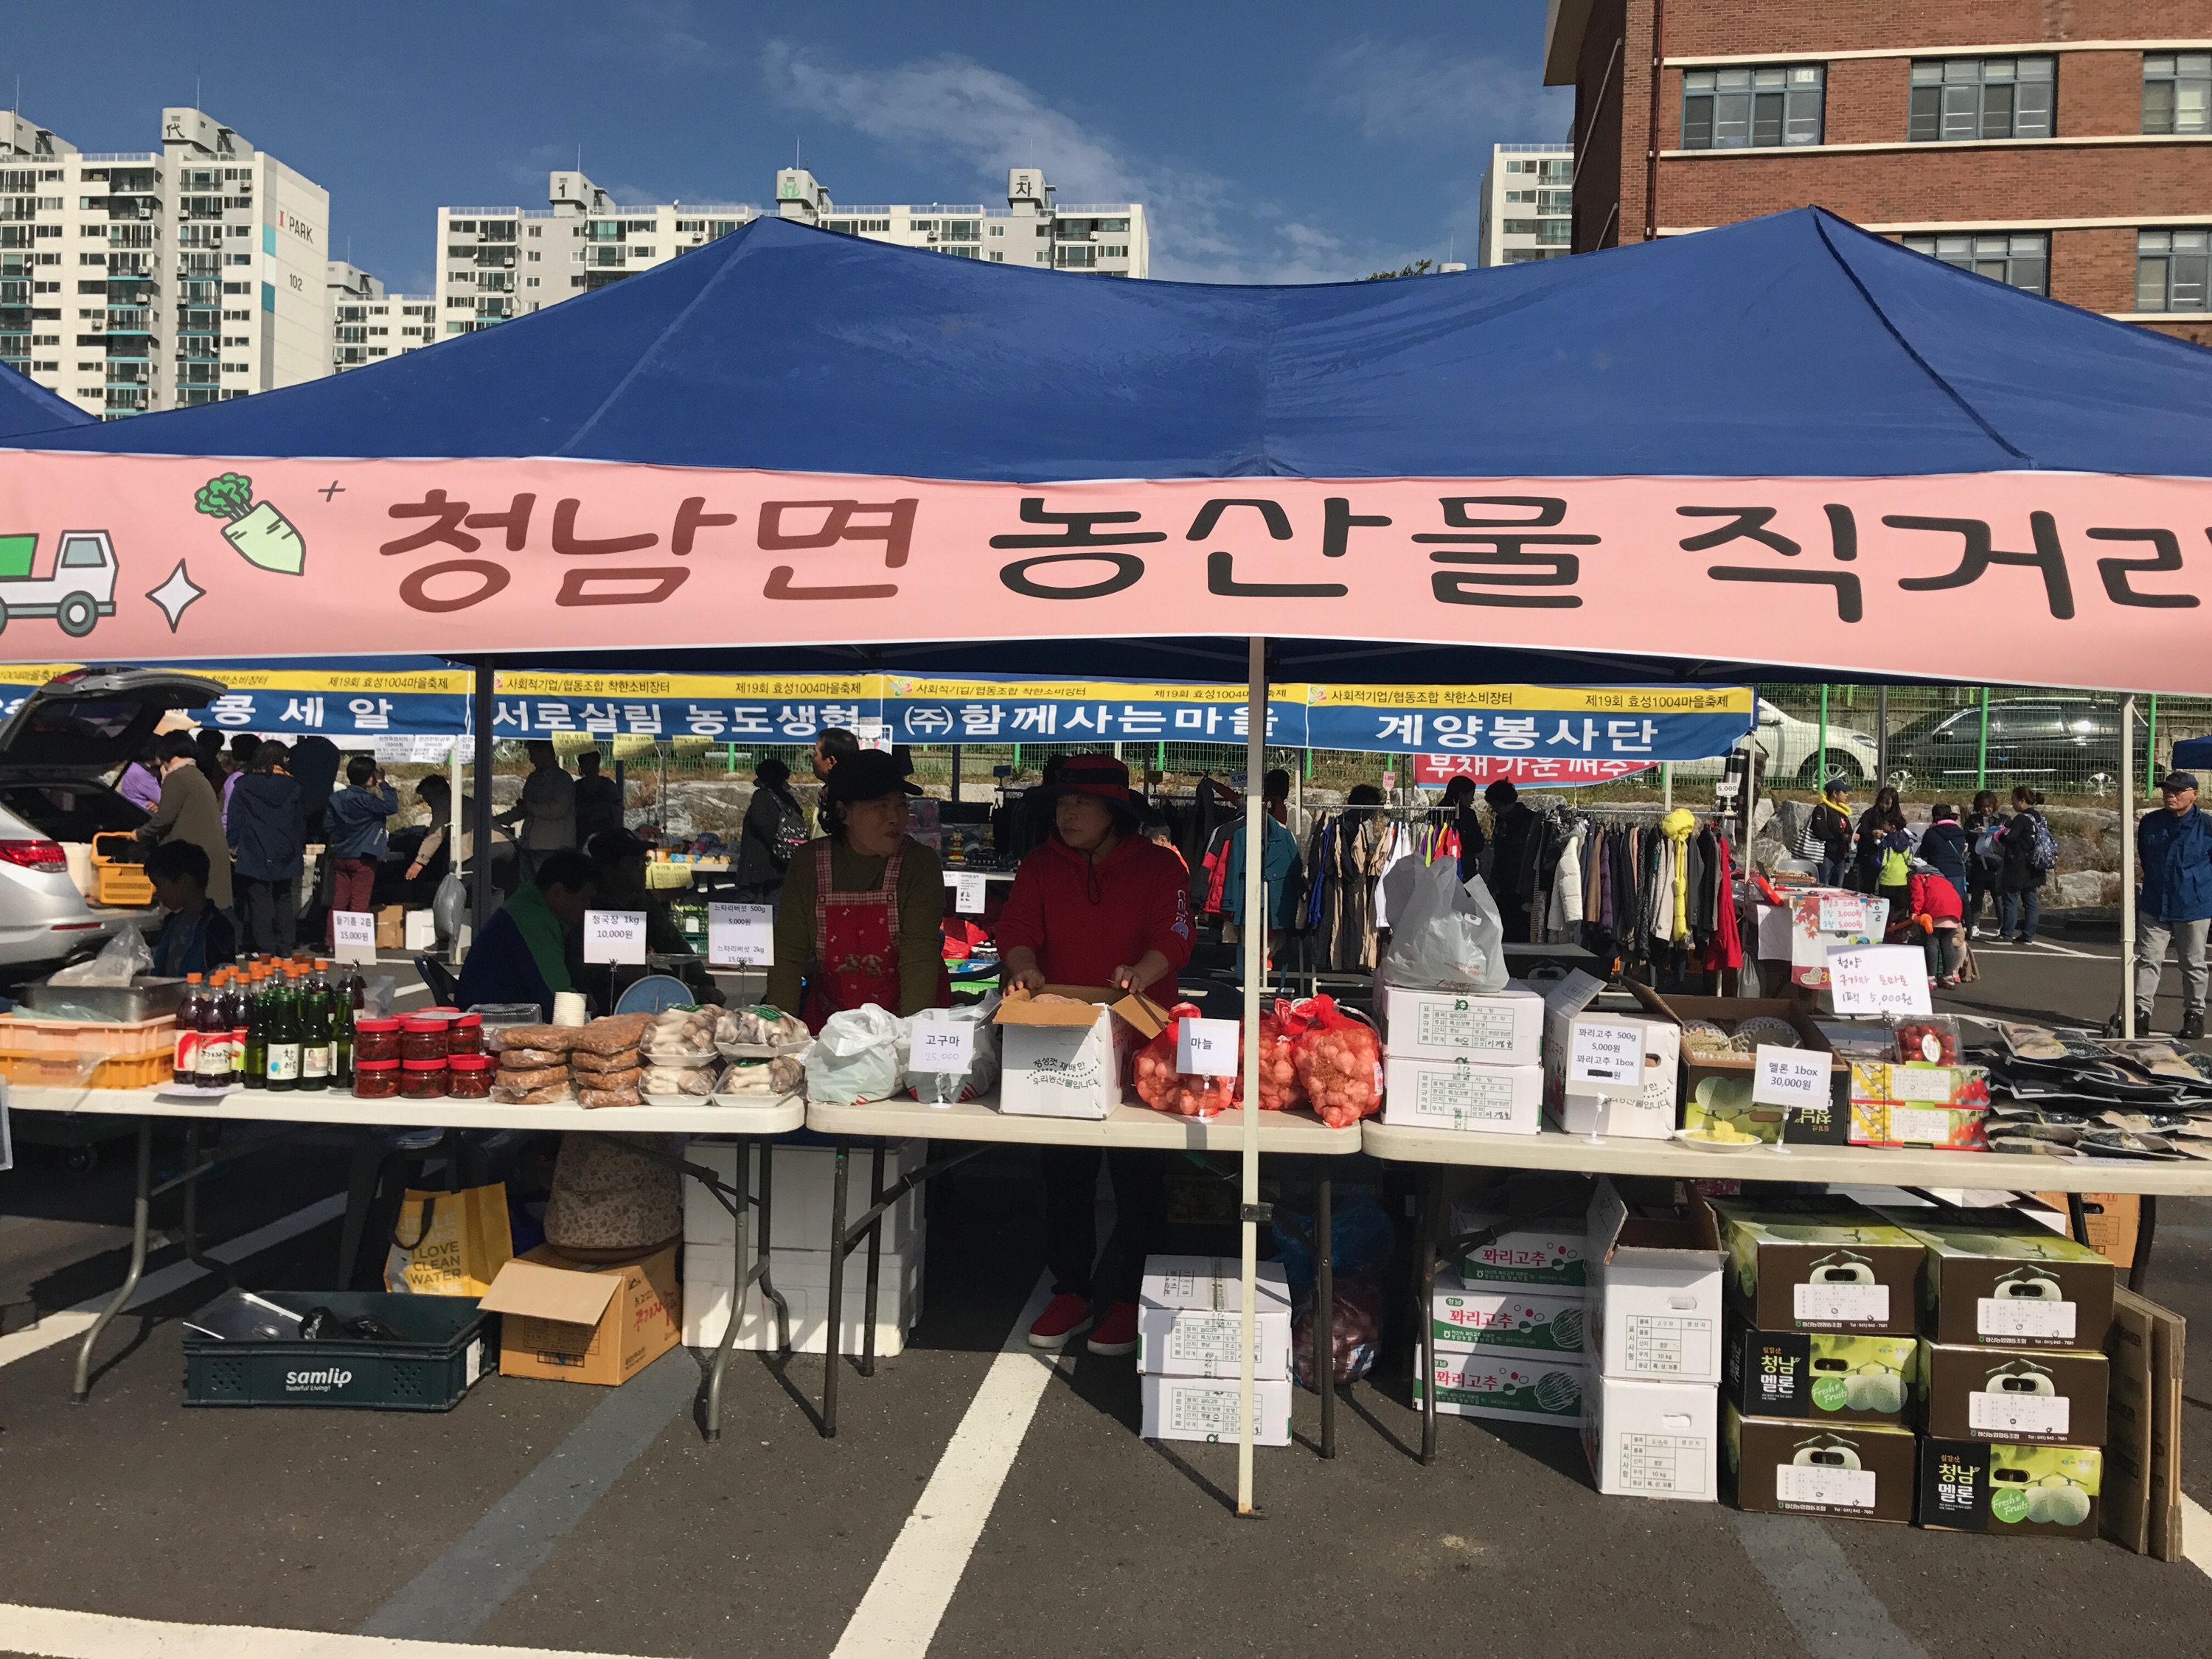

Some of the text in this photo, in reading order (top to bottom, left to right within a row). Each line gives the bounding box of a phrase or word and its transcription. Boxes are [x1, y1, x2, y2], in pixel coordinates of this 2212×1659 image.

[557, 183, 568, 198] 1
[1015, 181, 1033, 198] 차
[289, 273, 302, 292] 102
[379, 488, 919, 613] 청남면
[989, 495, 1602, 609] 농산물
[328, 676, 359, 689] 제19회
[362, 677, 448, 690] 효성1004마을축제
[507, 678, 862, 695] 사회적기업/협동조합 착한소비장터 제19회 효성1004마을축제
[917, 683, 1287, 700] 사회적기업/협동조합 착한소비장터 제19회 효성1004제
[1331, 689, 1729, 709] 사회적기업/협동조합 착한소비장터 제19회 효성1004마을축제
[211, 695, 393, 729] 콩 세 알
[493, 702, 859, 736] 서로살림 농도생협
[1375, 714, 1659, 752] 계양봉사단
[1568, 758, 1656, 776] 써주
[714, 904, 766, 914] 느타리버섯 500g
[336, 915, 358, 927] 들기름
[591, 914, 639, 925] 청국장 1kg
[728, 918, 751, 926] 5,000원
[340, 931, 369, 942] 15,000원
[597, 930, 633, 939] 10,000원
[717, 945, 765, 954] 느타리버섯 2kg
[1837, 956, 1863, 970] 청양
[1839, 974, 1909, 987] 구기자 토마토
[1842, 992, 1913, 1006] 1팩 5,000원
[925, 1034, 960, 1047] 고구마
[1578, 1028, 1636, 1042] 꽈리고추 500g
[1190, 1037, 1213, 1050] 마늘
[1591, 1043, 1621, 1054] 5,000원
[1059, 1060, 1085, 1072] 재배한
[1576, 1054, 1635, 1067] 꽈리고추 1box
[1769, 1062, 1818, 1077] 멜론 1box
[1032, 1074, 1097, 1090] 우리농산물입니다
[1770, 1077, 1812, 1091] 30,000원
[419, 1241, 459, 1259] LOVE
[1481, 1248, 1547, 1267] 꽈리고추
[413, 1254, 461, 1272] CLEAN
[410, 1267, 462, 1284] WATER
[1449, 1309, 1514, 1329] 꽈리고추
[1761, 1355, 1796, 1375] 청남
[285, 1367, 352, 1388] samlip
[1435, 1370, 1498, 1391] 꽈리고추
[1760, 1374, 1795, 1394] 멜론
[1812, 1382, 1834, 1397] Fresh
[1823, 1390, 1848, 1404] Fruits
[1938, 1463, 1975, 1485] 청남
[1938, 1484, 1975, 1505] 멜론
[1992, 1495, 2016, 1509] Fresh
[2003, 1502, 2028, 1515] Fruits
